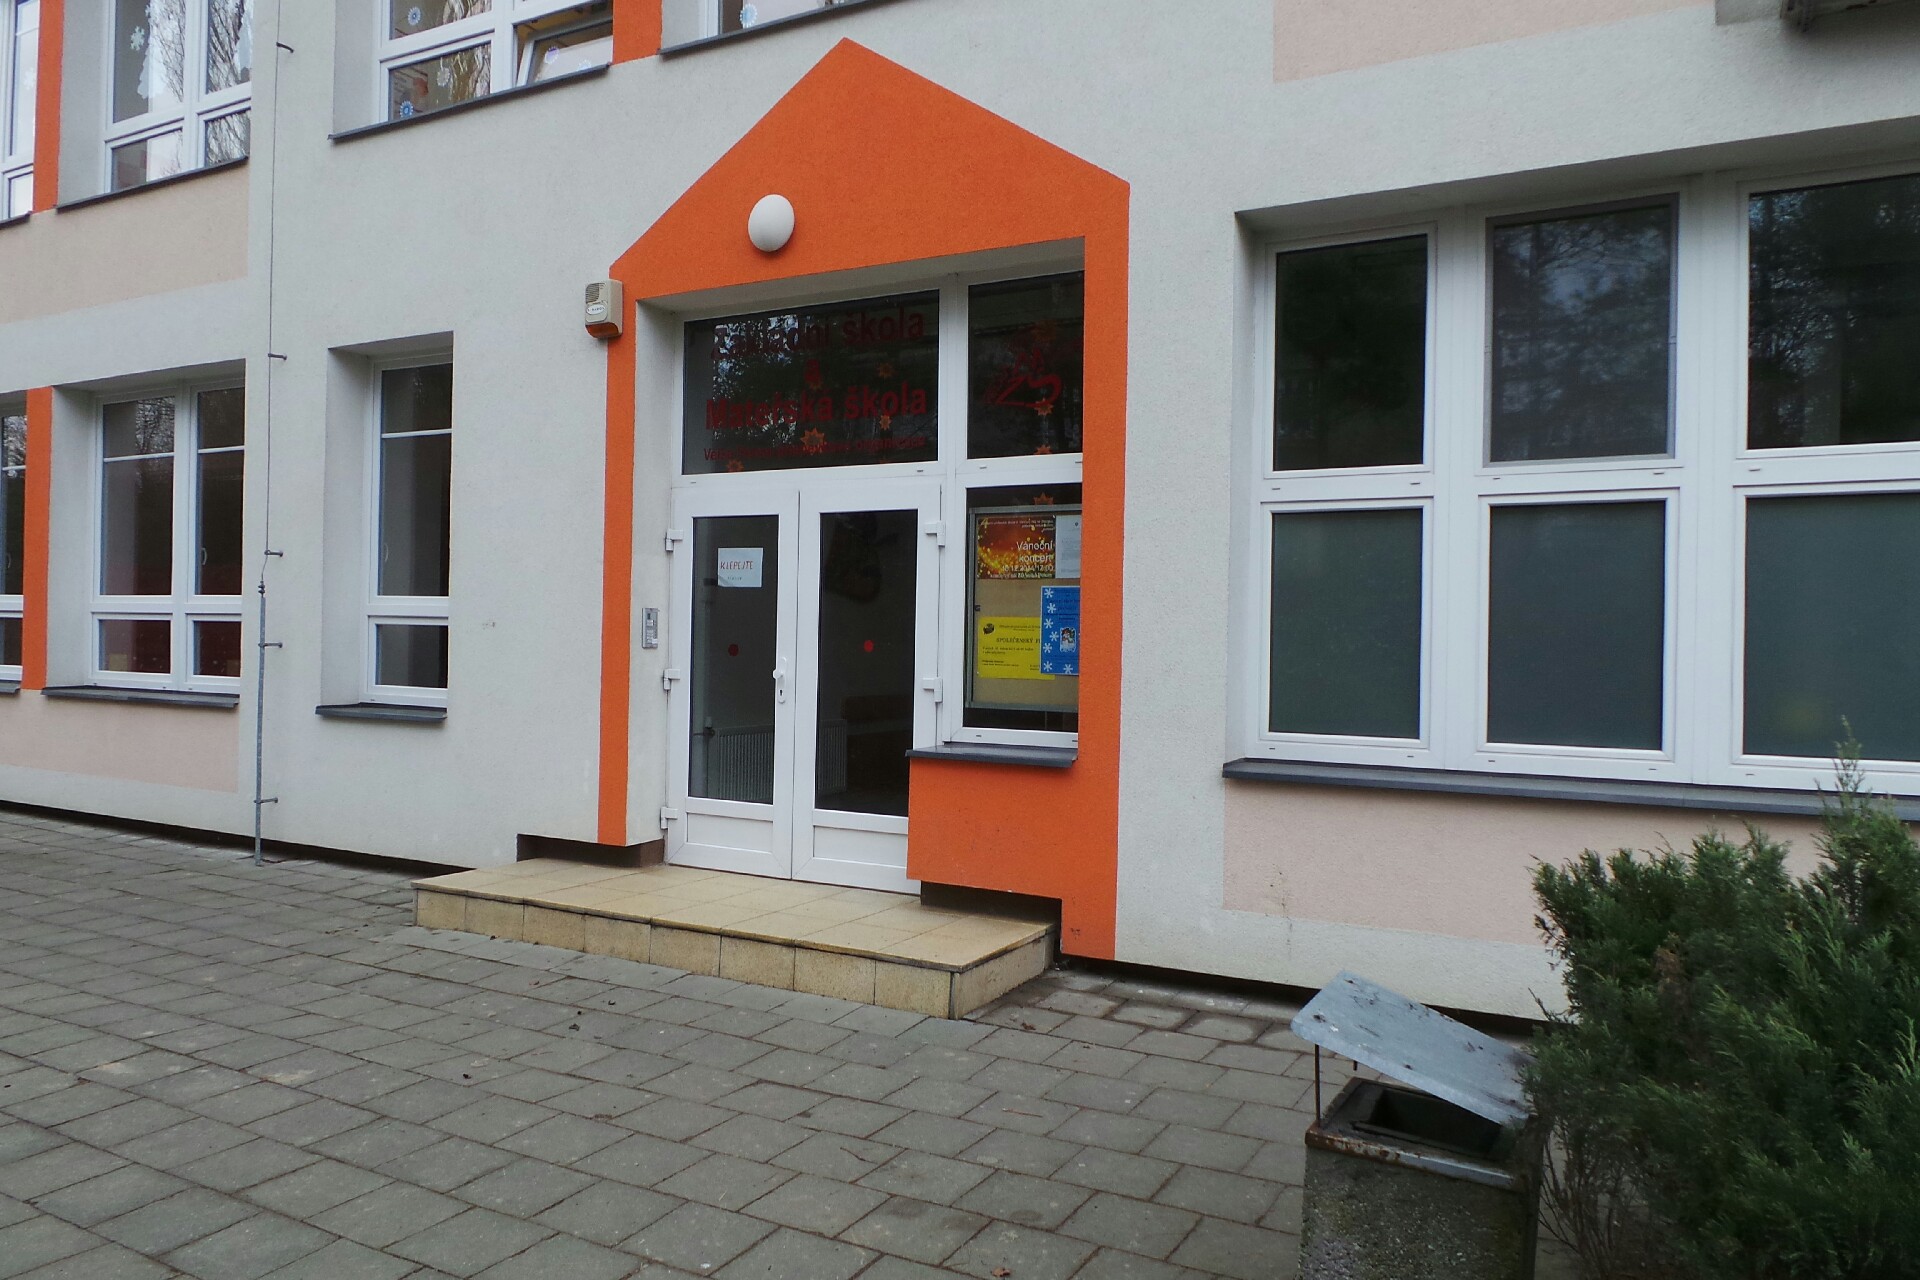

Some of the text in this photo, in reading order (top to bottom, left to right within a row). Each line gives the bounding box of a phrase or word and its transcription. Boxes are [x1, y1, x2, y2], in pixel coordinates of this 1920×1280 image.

[843, 306, 925, 346] škola
[804, 359, 821, 383] a
[706, 380, 928, 430] Mateřská škola
[1016, 540, 1053, 551] Vánoční
[1018, 554, 1053, 563] koncert
